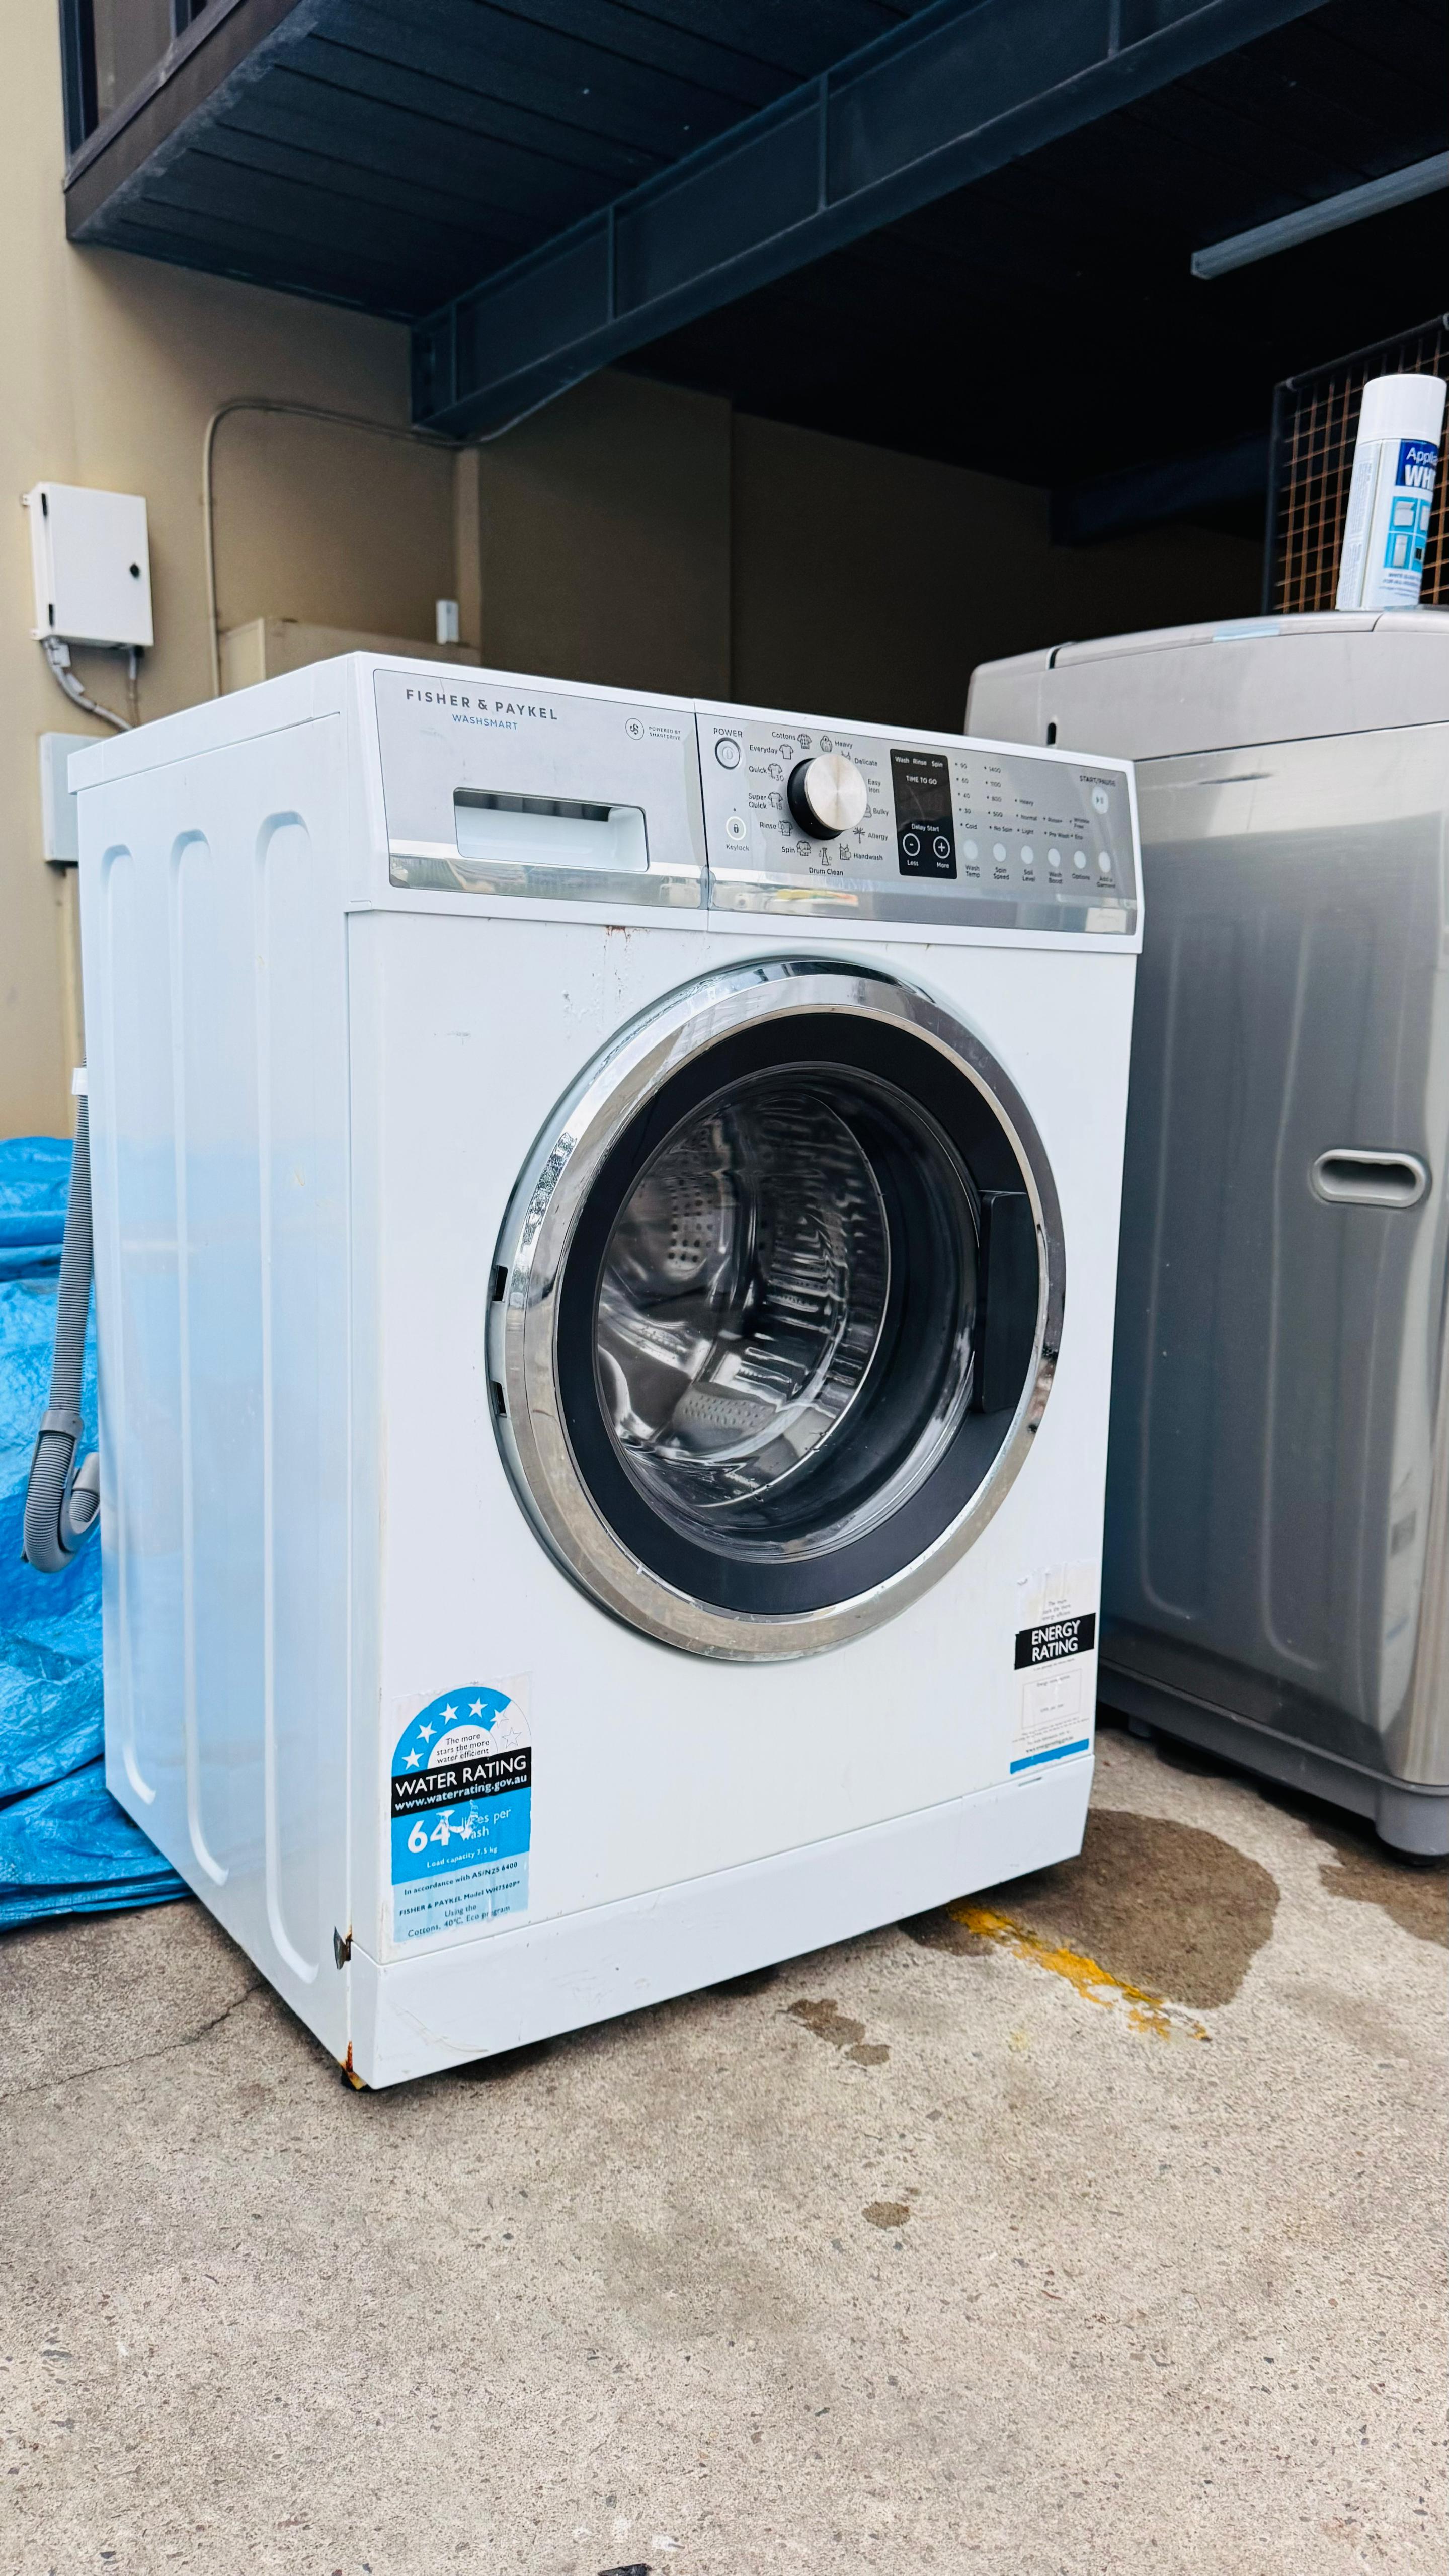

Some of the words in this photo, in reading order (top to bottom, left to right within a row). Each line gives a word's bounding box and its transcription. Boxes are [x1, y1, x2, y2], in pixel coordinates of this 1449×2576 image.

[406, 689, 470, 708] FISHER
[478, 699, 488, 710] &
[495, 701, 557, 720] PAYKEL
[452, 714, 518, 730] WASHSMART
[714, 728, 743, 738] POWER
[772, 732, 796, 740] Cottons
[750, 745, 778, 754] Everyday
[835, 741, 853, 749] Heavy
[854, 758, 878, 766] Delicate
[906, 775, 919, 783] TIME
[873, 808, 889, 816] Bulky
[911, 824, 926, 832] Delay
[868, 833, 888, 841] Allergy
[854, 853, 883, 861] Handwash
[1031, 1620, 1081, 1645] ENERGY
[1032, 1636, 1078, 1662] RATING
[461, 1734, 480, 1742] more
[437, 1748, 454, 1756] stars
[456, 1744, 468, 1752] the
[469, 1740, 490, 1749] more
[437, 1754, 458, 1764] water
[460, 1748, 490, 1759] efficient
[395, 1770, 457, 1797] WATER
[462, 1755, 527, 1784] RATING
[394, 1774, 527, 1812] www.waterrating.gov.au
[462, 1814, 489, 1831] lies
[493, 1809, 511, 1824] per
[427, 1858, 445, 1868] Load
[446, 1852, 475, 1864] capacity
[477, 1847, 487, 1856] 7.5
[489, 1846, 498, 1854] kg
[413, 1880, 454, 1893] accordance
[455, 1874, 470, 1883] with
[472, 1866, 500, 1879] AS/NZS
[502, 1862, 518, 1871] 6400
[399, 1905, 425, 1916] FISHER
[435, 1896, 462, 1907] PAYKEL
[464, 1891, 484, 1900] Model
[445, 1907, 463, 1917] Using
[408, 1925, 441, 1937] Cottons,
